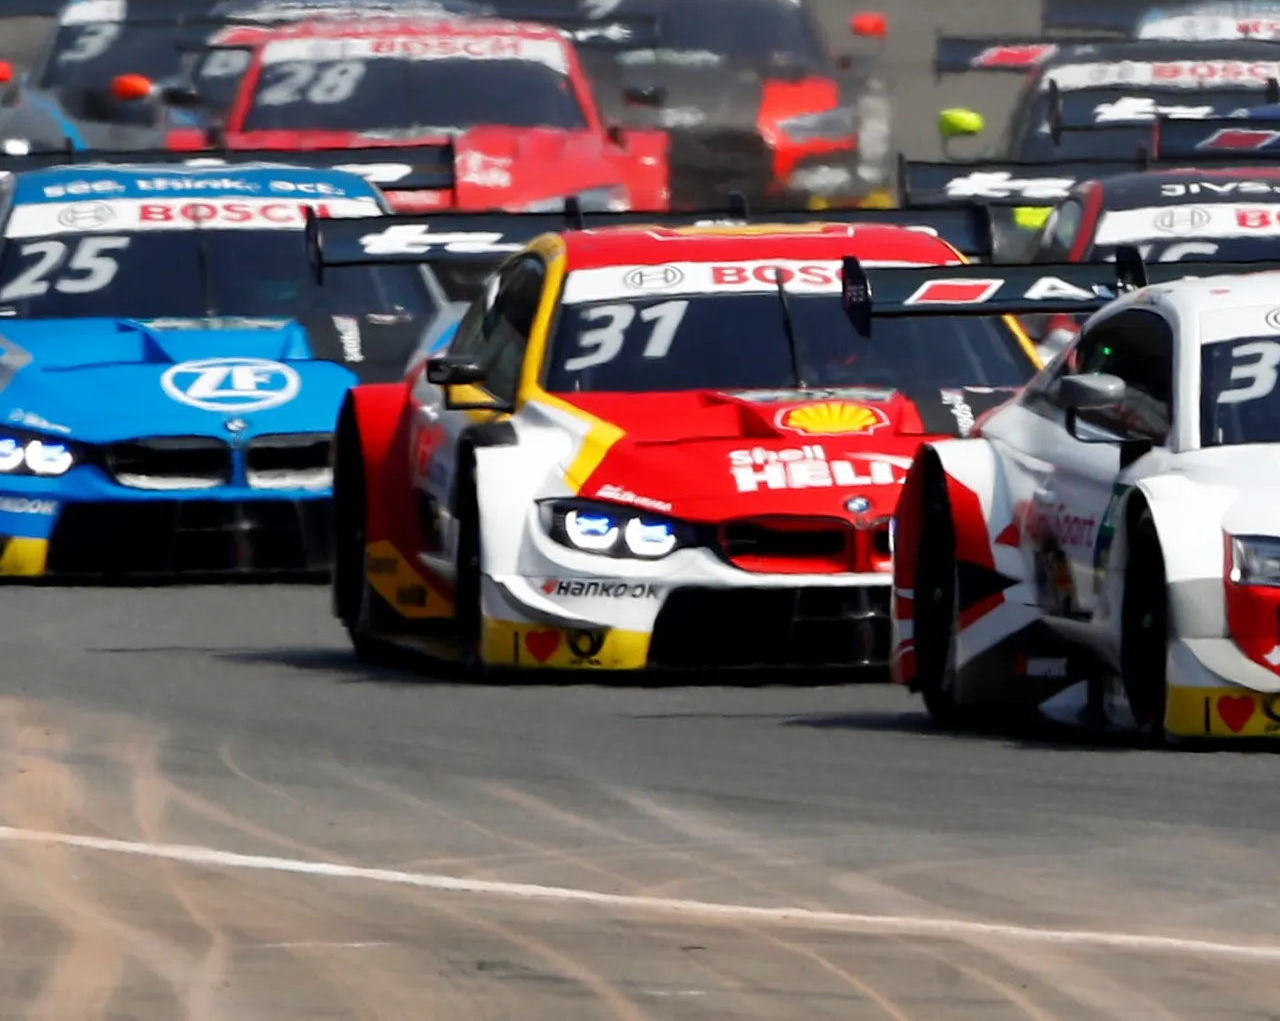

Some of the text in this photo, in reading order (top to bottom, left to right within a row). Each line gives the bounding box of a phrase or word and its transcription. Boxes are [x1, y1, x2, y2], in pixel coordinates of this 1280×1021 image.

[369, 38, 524, 57] BOSCH
[256, 59, 368, 106] 28
[43, 178, 127, 198] see.
[0, 236, 132, 301] 25
[711, 265, 845, 287] BOS
[564, 300, 690, 372] 31
[187, 366, 271, 399] ZF
[729, 444, 826, 467] Shell
[730, 459, 912, 493] HELI
